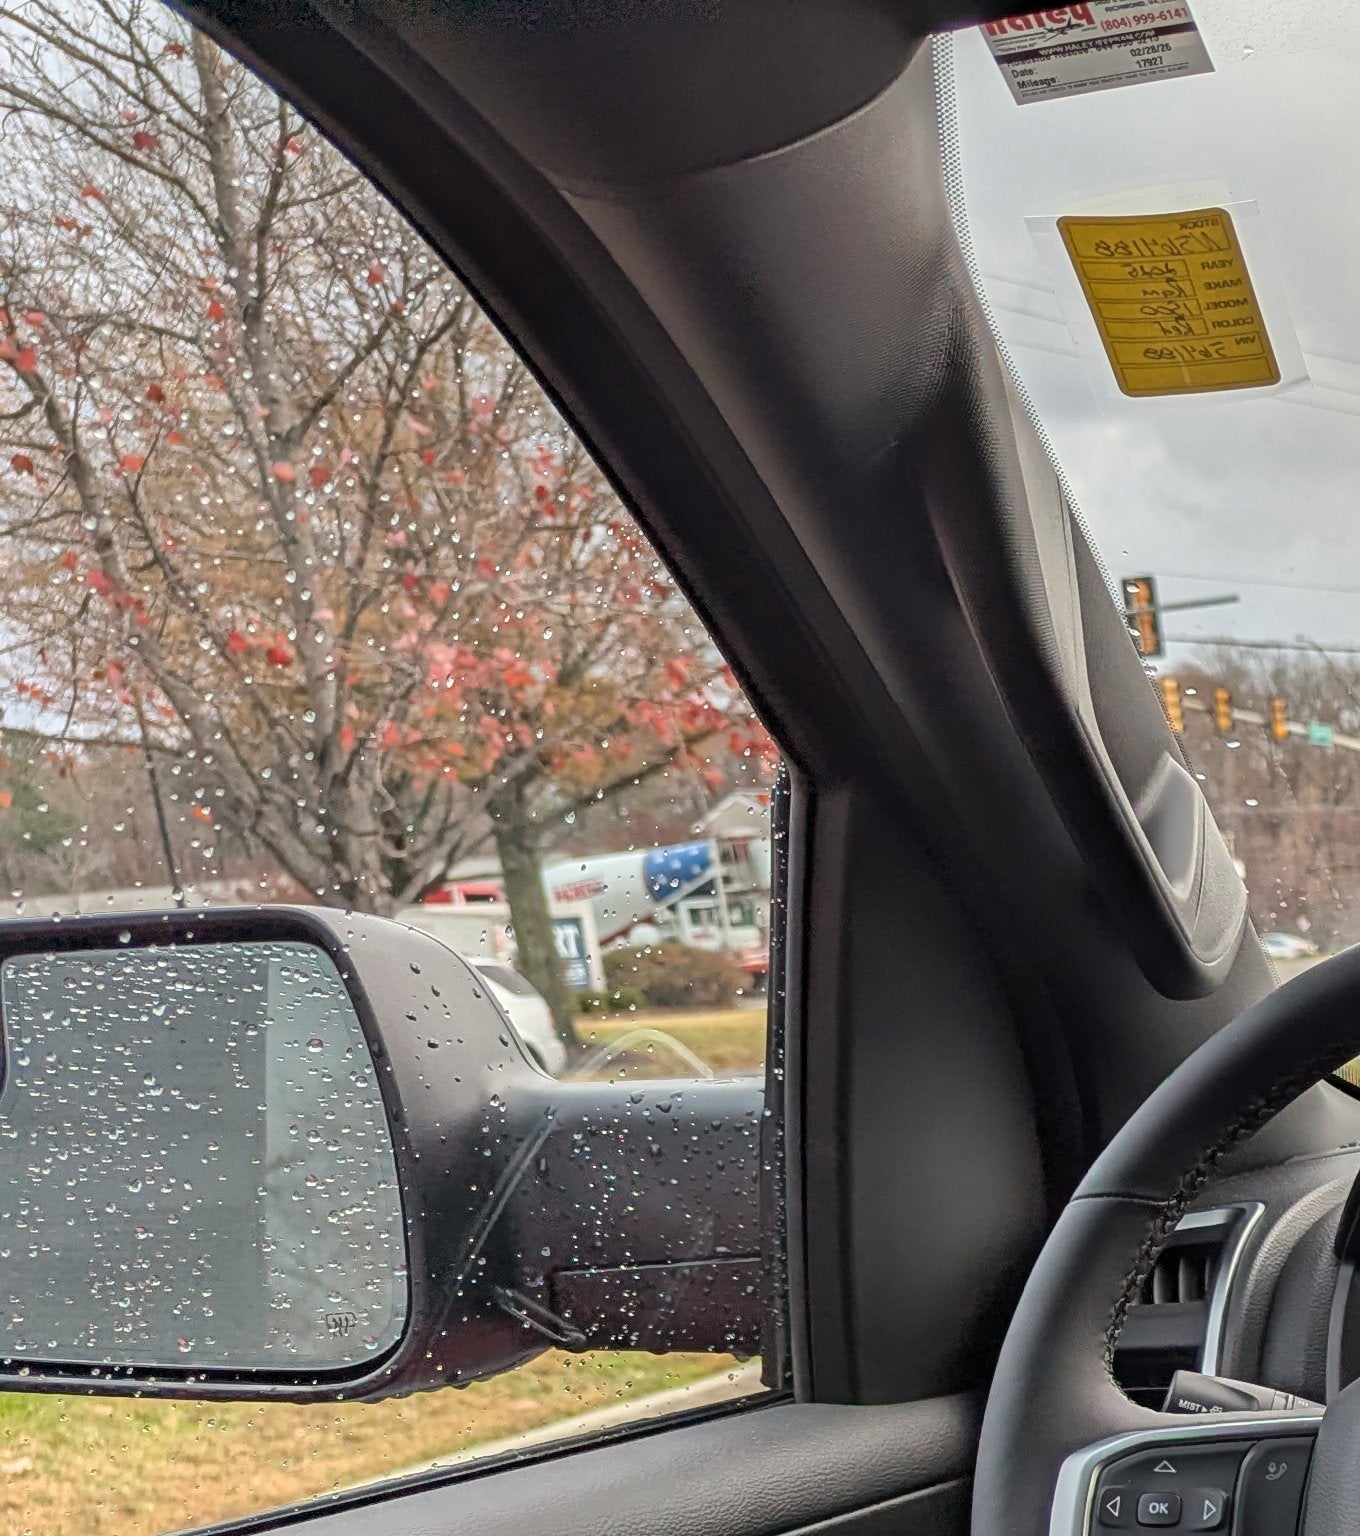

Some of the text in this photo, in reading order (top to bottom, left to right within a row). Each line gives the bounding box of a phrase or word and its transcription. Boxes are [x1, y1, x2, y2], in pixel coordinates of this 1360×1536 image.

[1100, 8, 1189, 32] (804) 999-6141
[1011, 66, 1037, 79] Date:
[1016, 76, 1060, 90] Mileage:
[1178, 1399, 1200, 1413] MIST
[1149, 1502, 1169, 1515] OK
